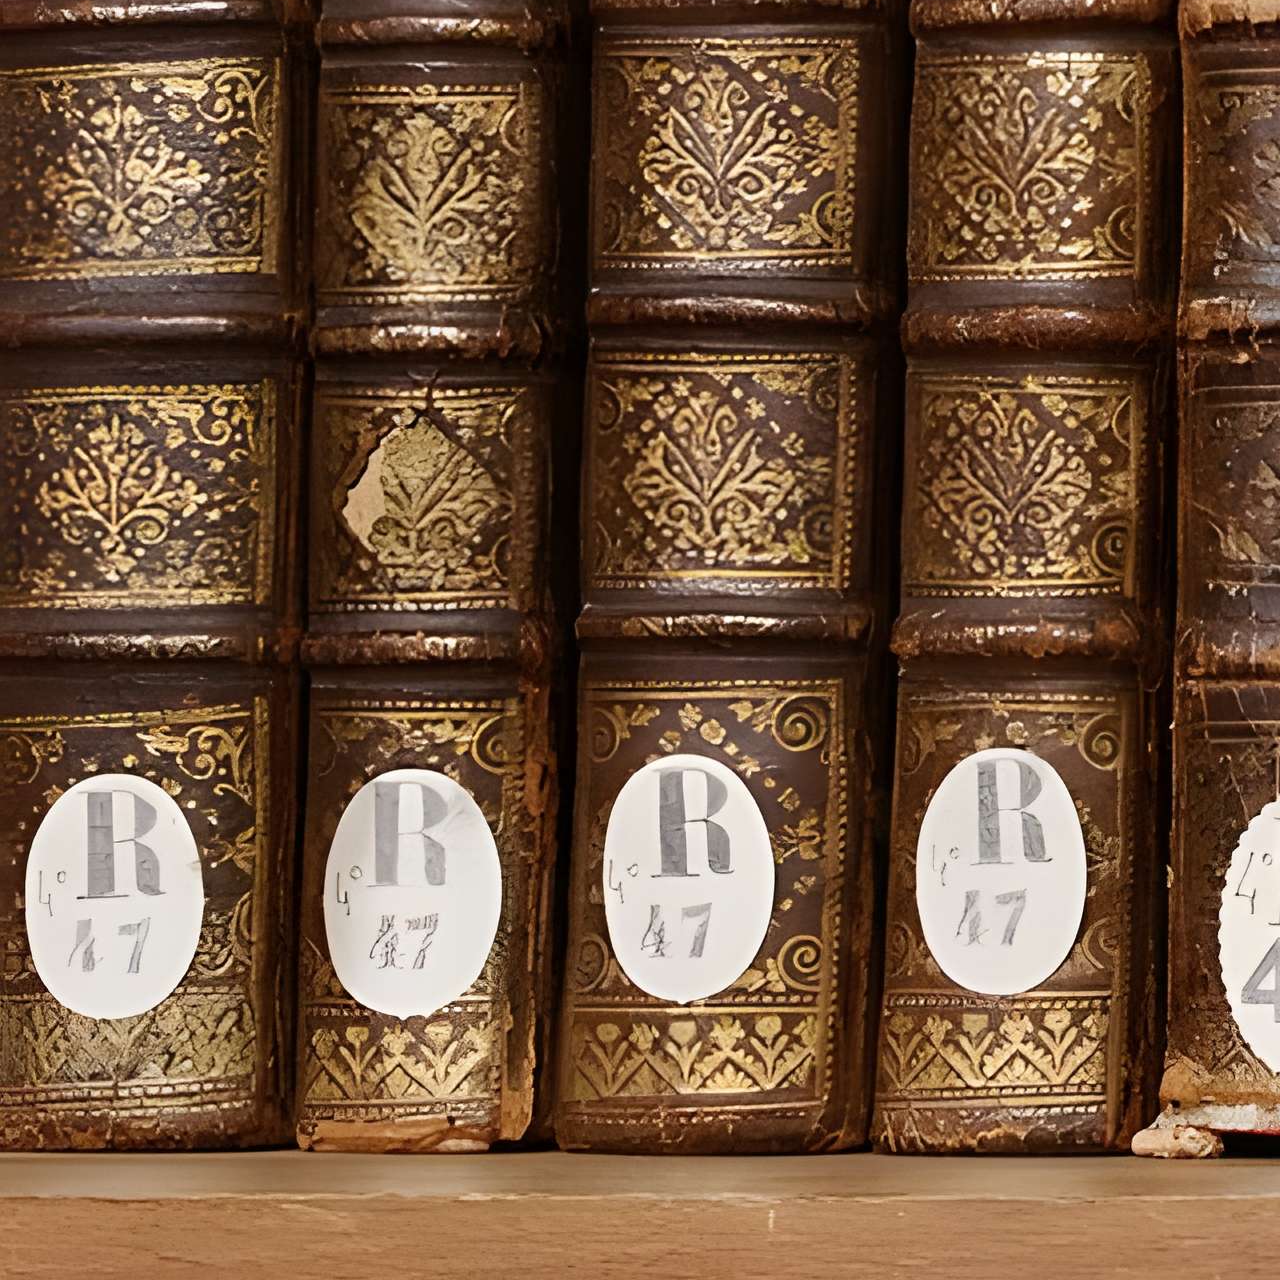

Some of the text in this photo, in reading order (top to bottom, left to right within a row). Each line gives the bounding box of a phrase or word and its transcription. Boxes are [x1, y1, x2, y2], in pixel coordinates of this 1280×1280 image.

[75, 789, 168, 900] R
[364, 780, 450, 888] R
[649, 768, 735, 879] R
[970, 759, 1054, 867] R
[641, 902, 713, 959] 47
[954, 888, 1028, 947] 47
